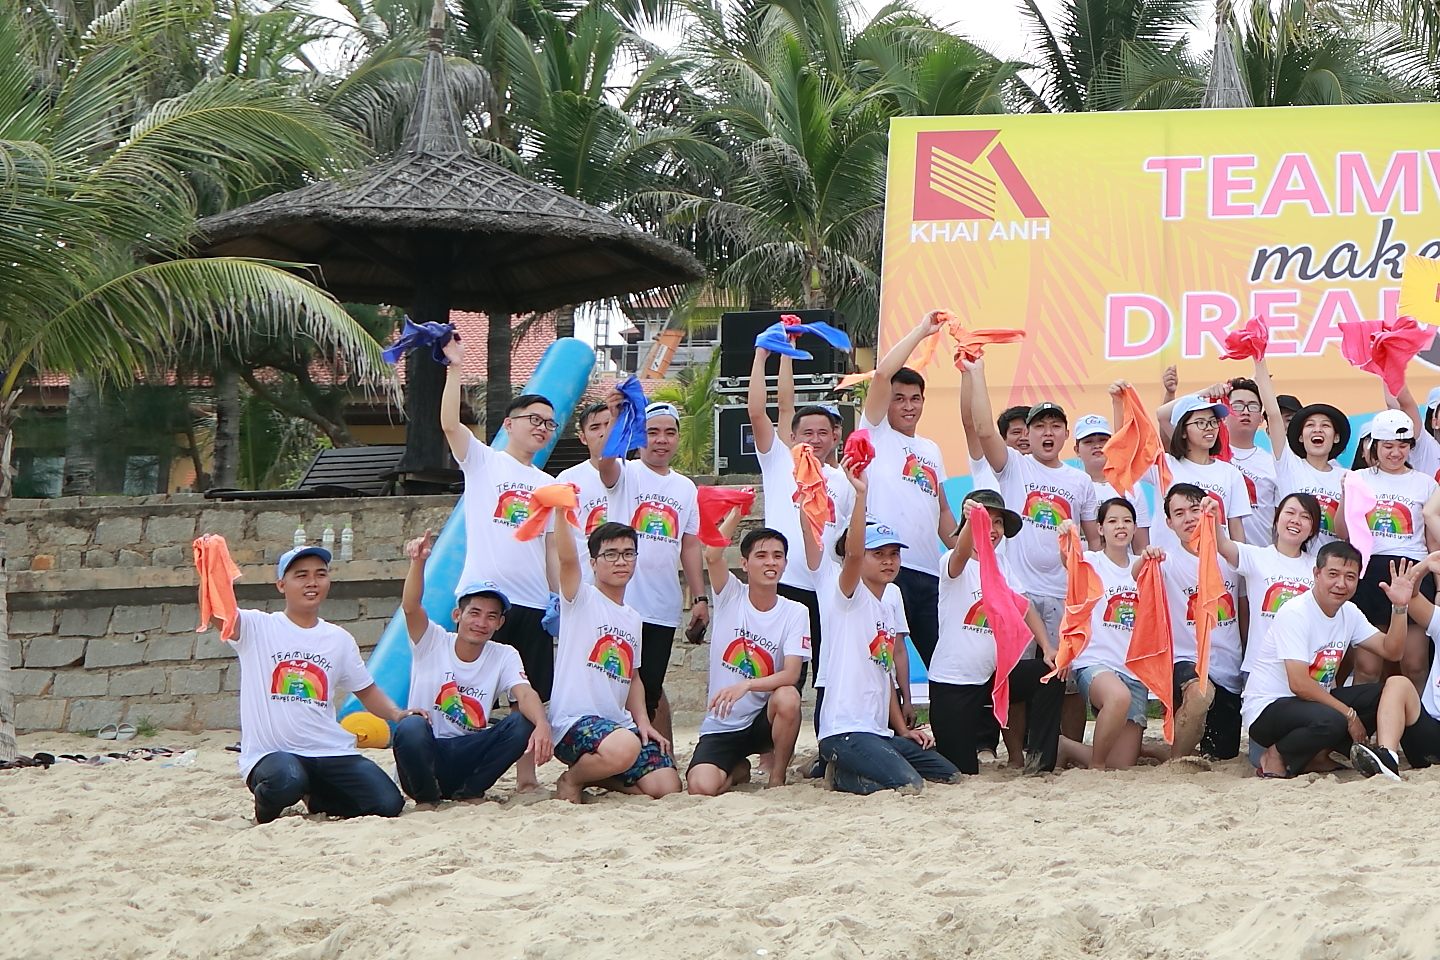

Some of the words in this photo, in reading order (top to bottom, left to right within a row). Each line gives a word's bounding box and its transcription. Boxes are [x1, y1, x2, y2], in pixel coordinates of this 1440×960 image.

[910, 221, 979, 243] KHAI
[988, 220, 1050, 241] ANH
[635, 493, 684, 514] TEAMWORK
[271, 650, 333, 673] TEAMWORK
